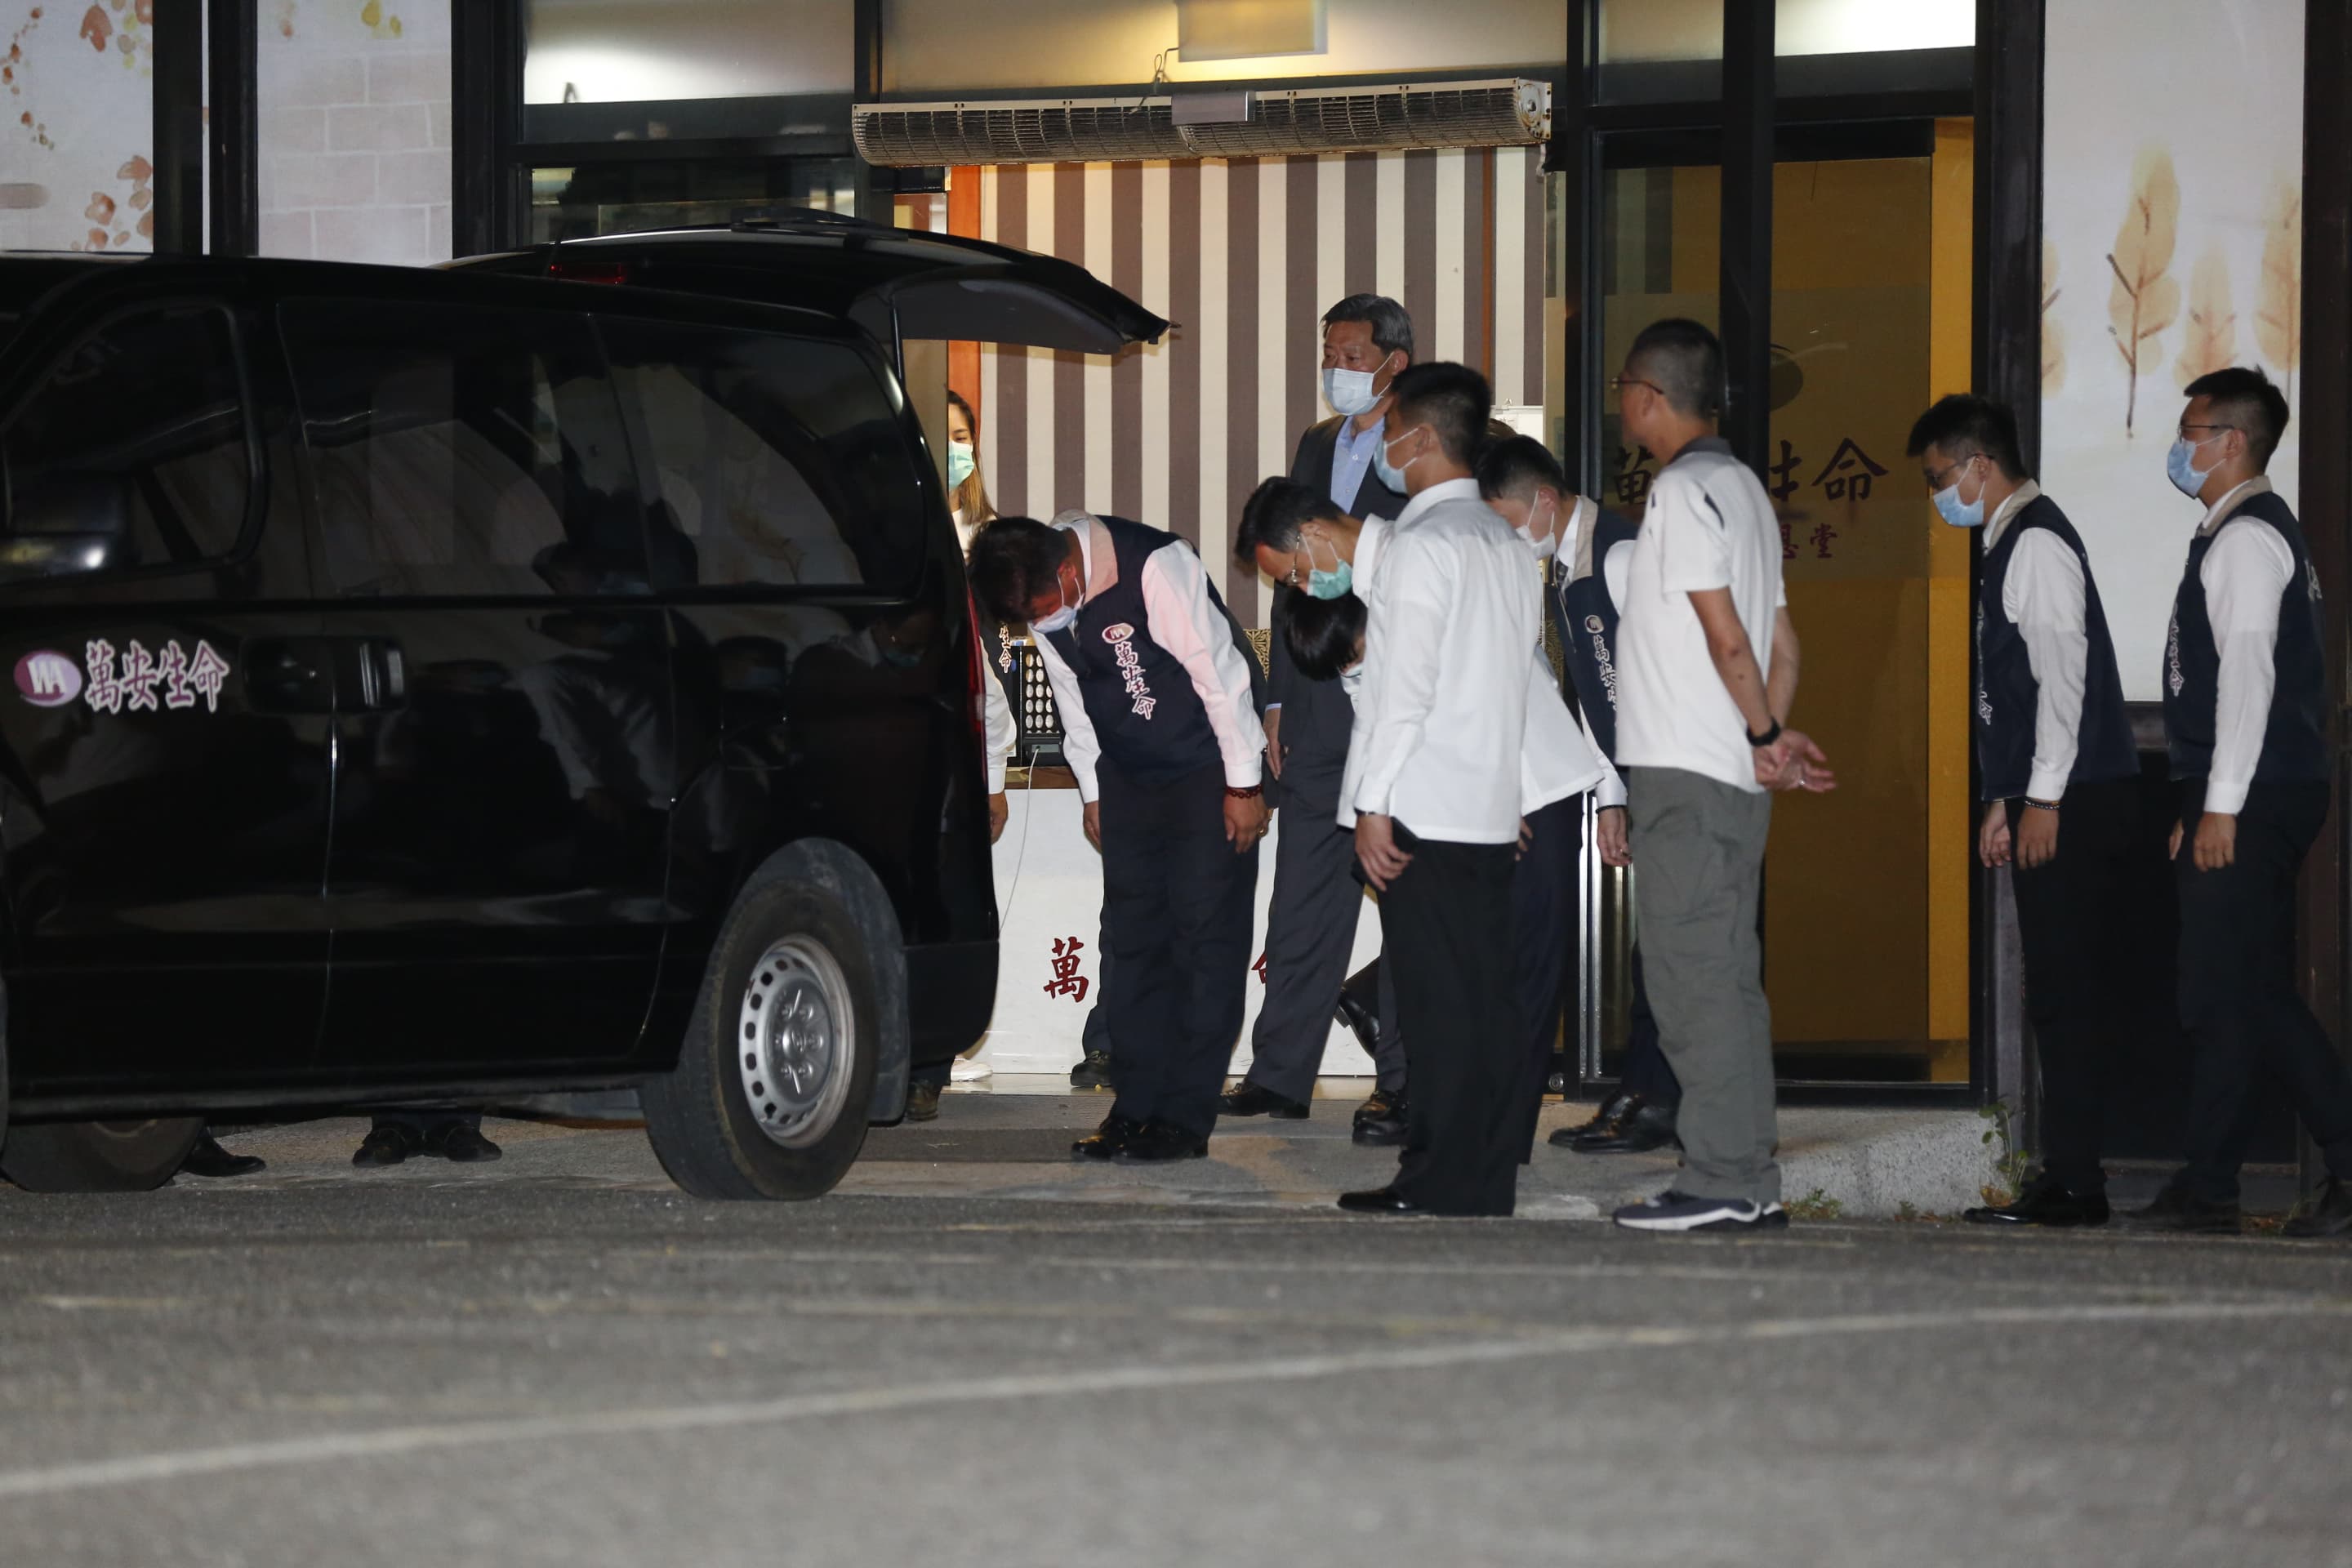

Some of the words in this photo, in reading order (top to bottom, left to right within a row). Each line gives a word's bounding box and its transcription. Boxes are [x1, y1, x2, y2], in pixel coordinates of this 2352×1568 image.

[85, 639, 229, 714] 萬安生命
[1044, 936, 1089, 1003] 萬
